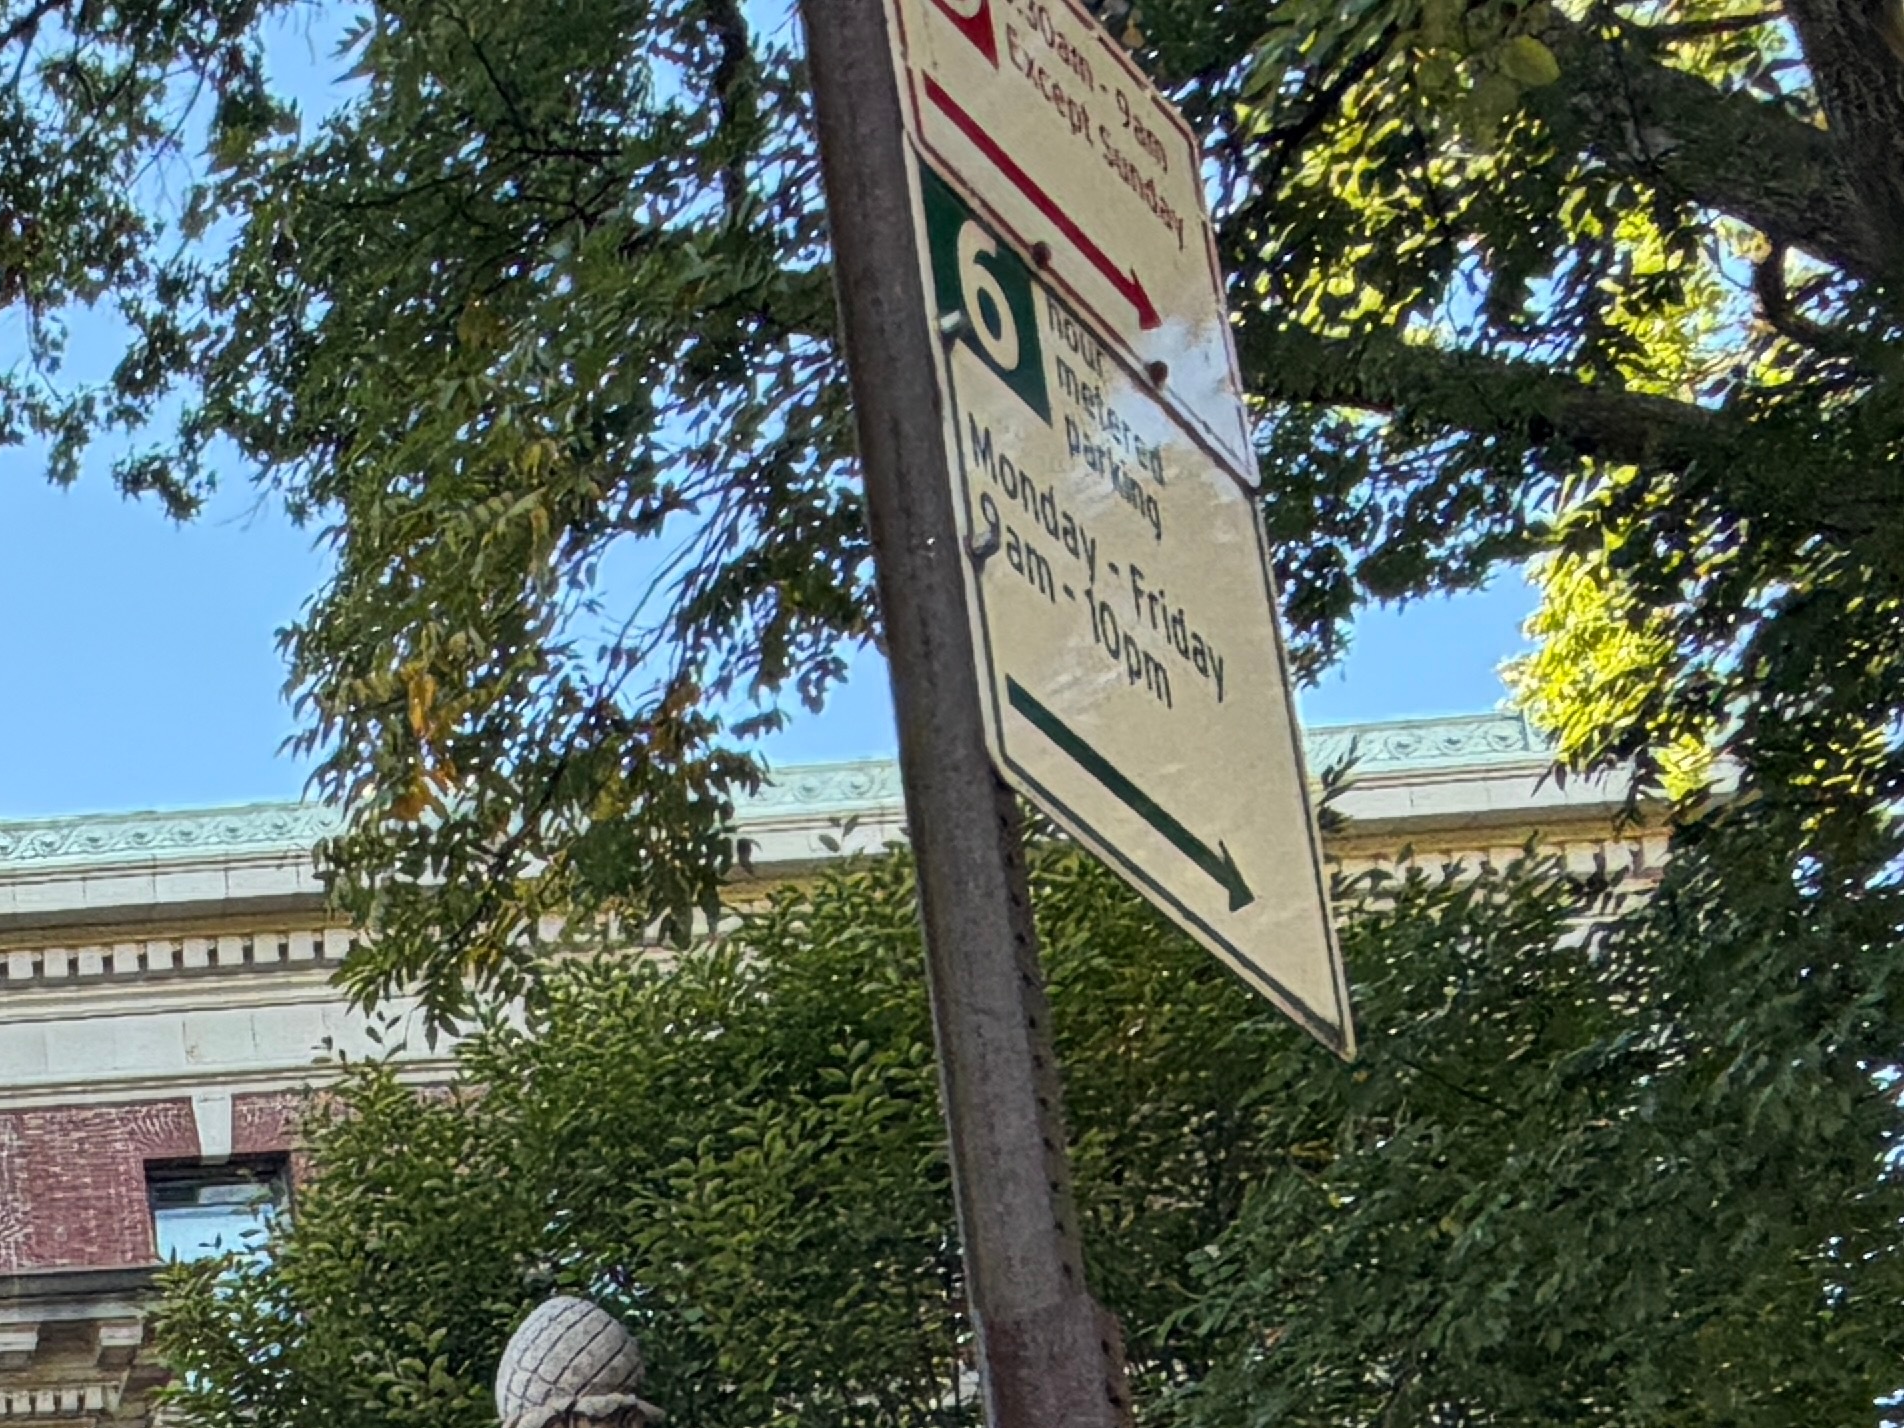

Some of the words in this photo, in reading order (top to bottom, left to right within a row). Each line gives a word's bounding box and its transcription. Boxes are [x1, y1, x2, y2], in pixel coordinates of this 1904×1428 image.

[1005, 22, 1094, 147] Except
[1098, 124, 1184, 251] Sunday
[957, 219, 1020, 372] 6
[1056, 354, 1165, 487] metered
[1064, 413, 1163, 545] parking
[968, 411, 1096, 587] Monday
[1129, 562, 1224, 704] Friday
[980, 491, 1056, 604] 9am
[1084, 587, 1172, 710] 10pm
